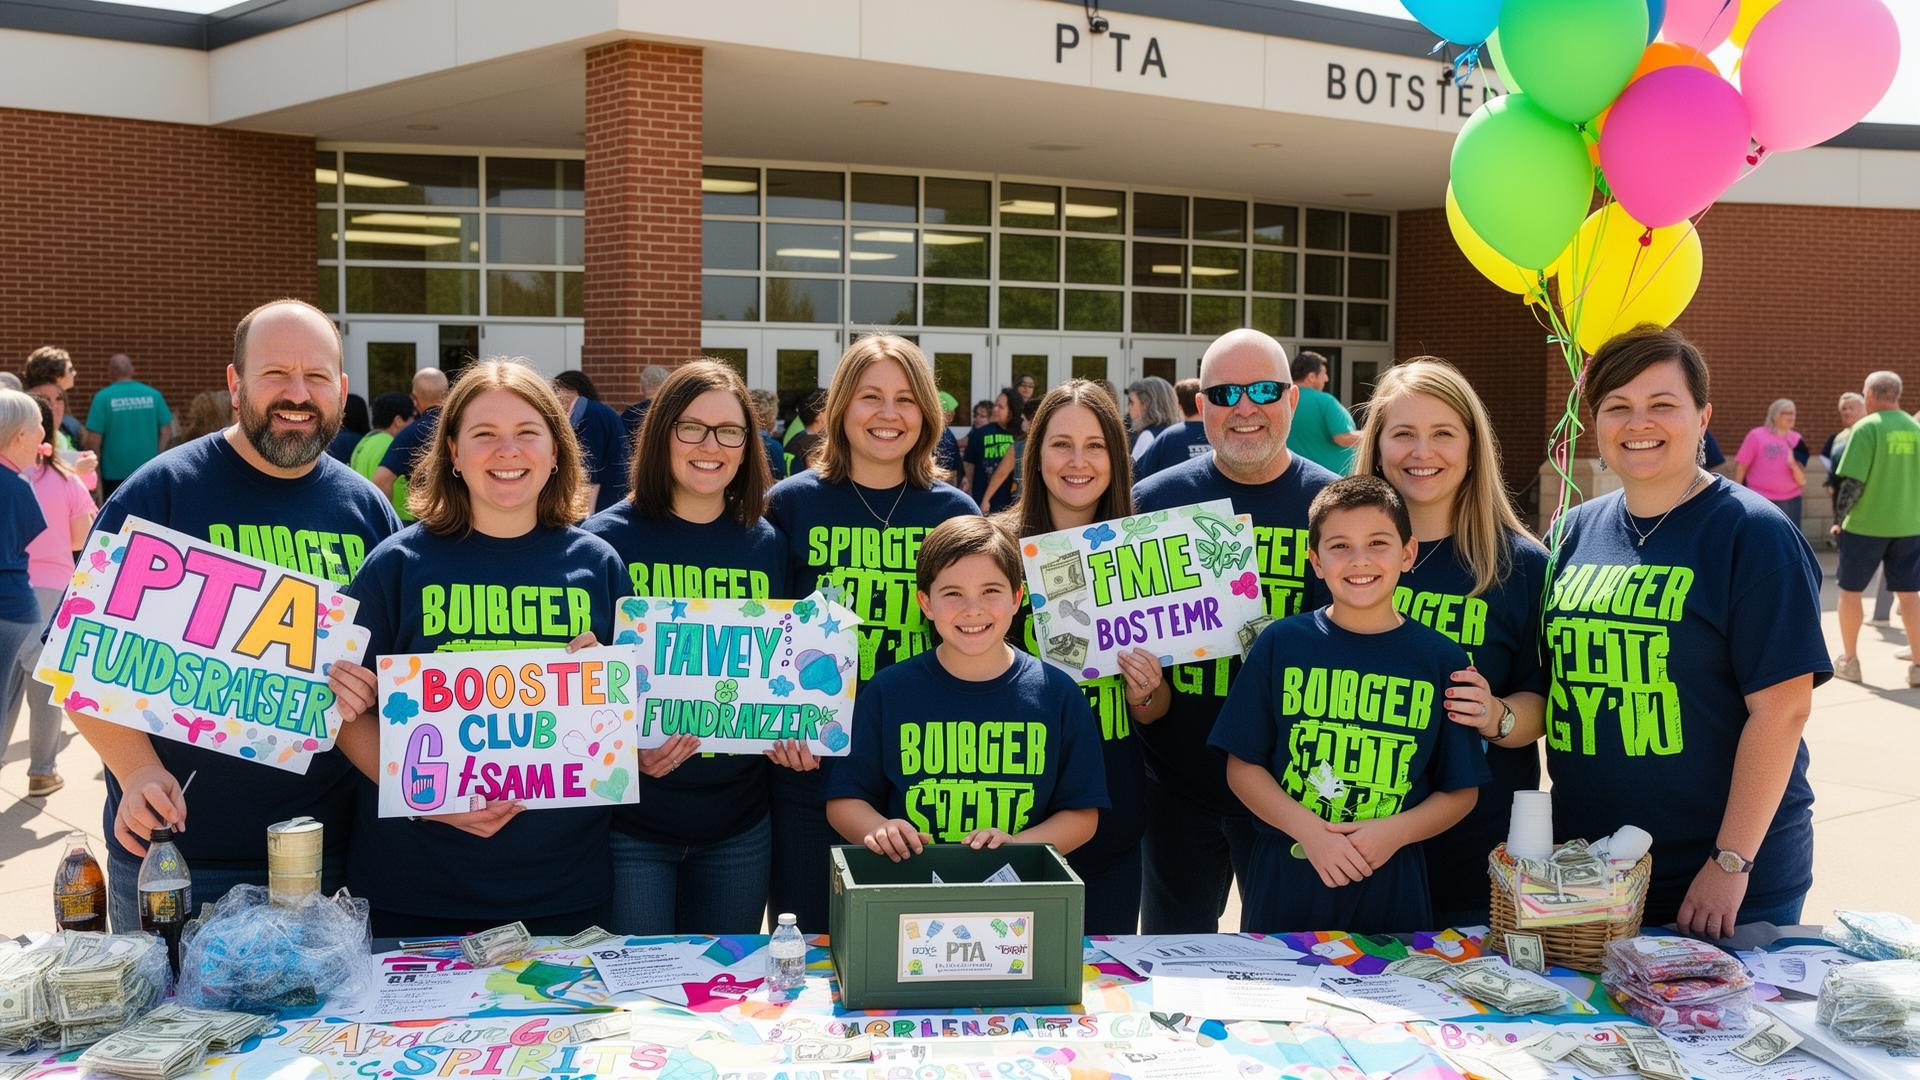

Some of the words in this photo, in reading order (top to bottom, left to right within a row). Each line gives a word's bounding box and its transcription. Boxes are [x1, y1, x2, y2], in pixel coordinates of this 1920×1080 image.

[1055, 23, 1168, 79] PTA
[103, 530, 320, 674] PTA
[59, 616, 337, 739] FUNDSRAISER
[422, 661, 631, 712] BOOSTER
[459, 710, 557, 752] CLUB
[641, 698, 820, 741] FUNDRAIZER
[946, 941, 987, 962] PTA
[393, 1044, 668, 1077] SPIRITS
